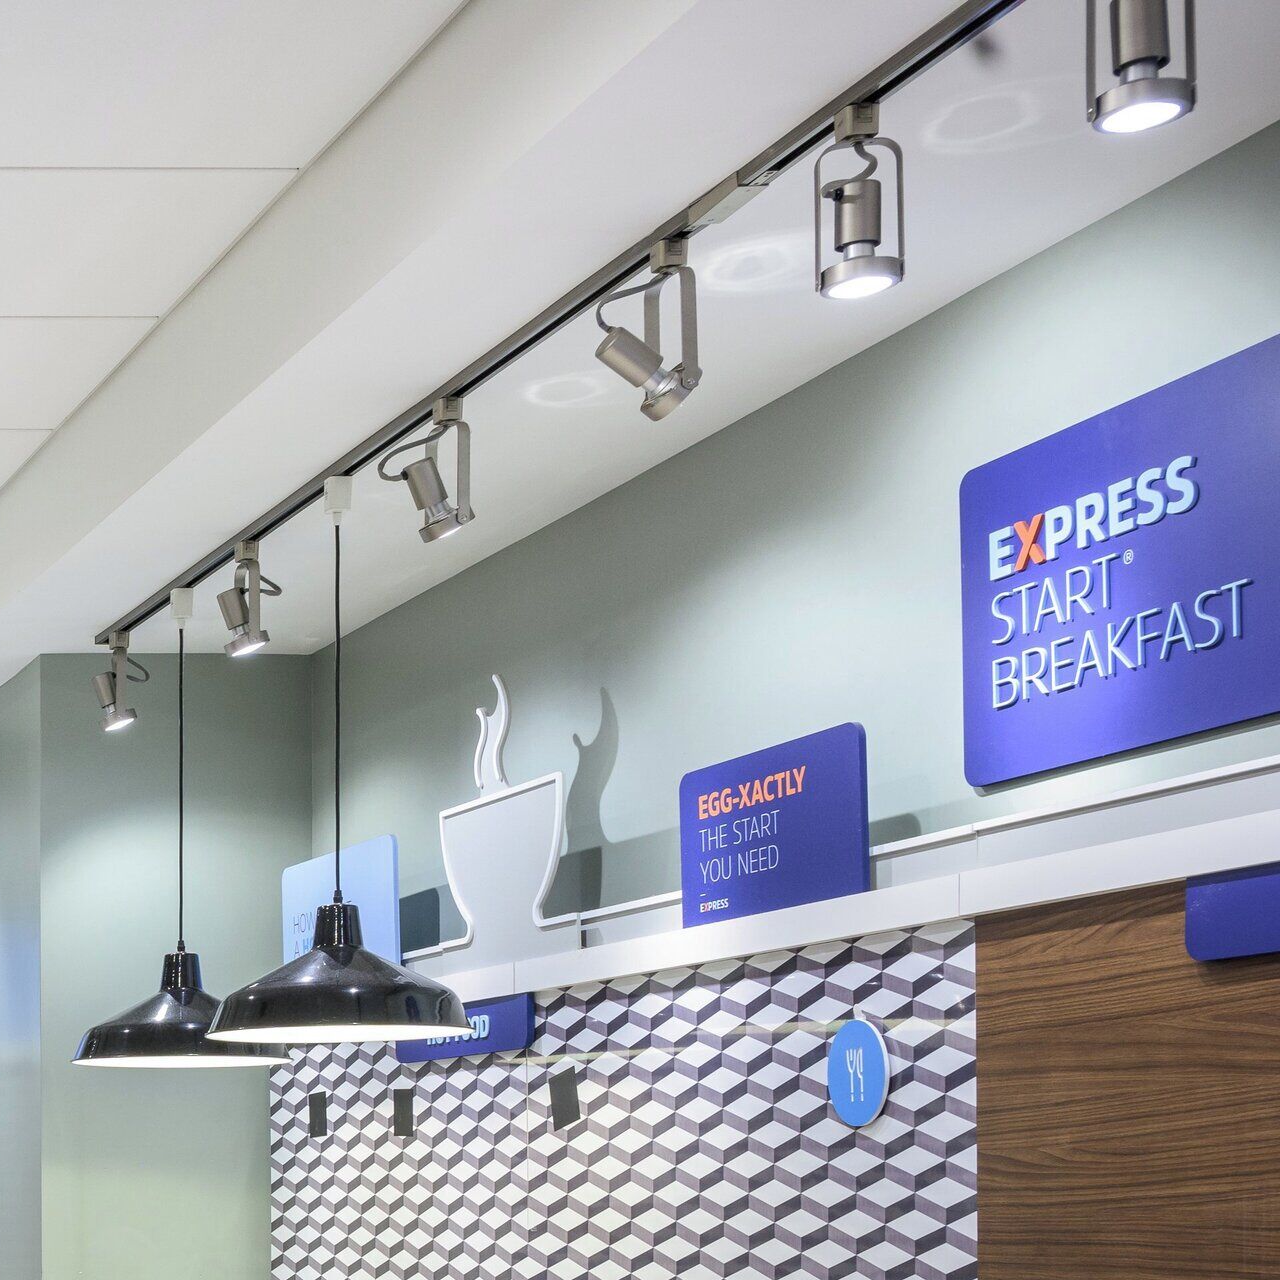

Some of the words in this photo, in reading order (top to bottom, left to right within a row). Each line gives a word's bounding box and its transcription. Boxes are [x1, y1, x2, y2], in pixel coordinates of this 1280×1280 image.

[988, 455, 1199, 582] EXPRESS
[992, 577, 1254, 711] BREAKFAST
[698, 765, 806, 820] EGG-XACTLY
[699, 823, 728, 853] THE
[732, 809, 780, 845] START
[699, 855, 732, 885] YOU
[737, 844, 779, 876] NEED
[699, 898, 729, 913] EXPRESS
